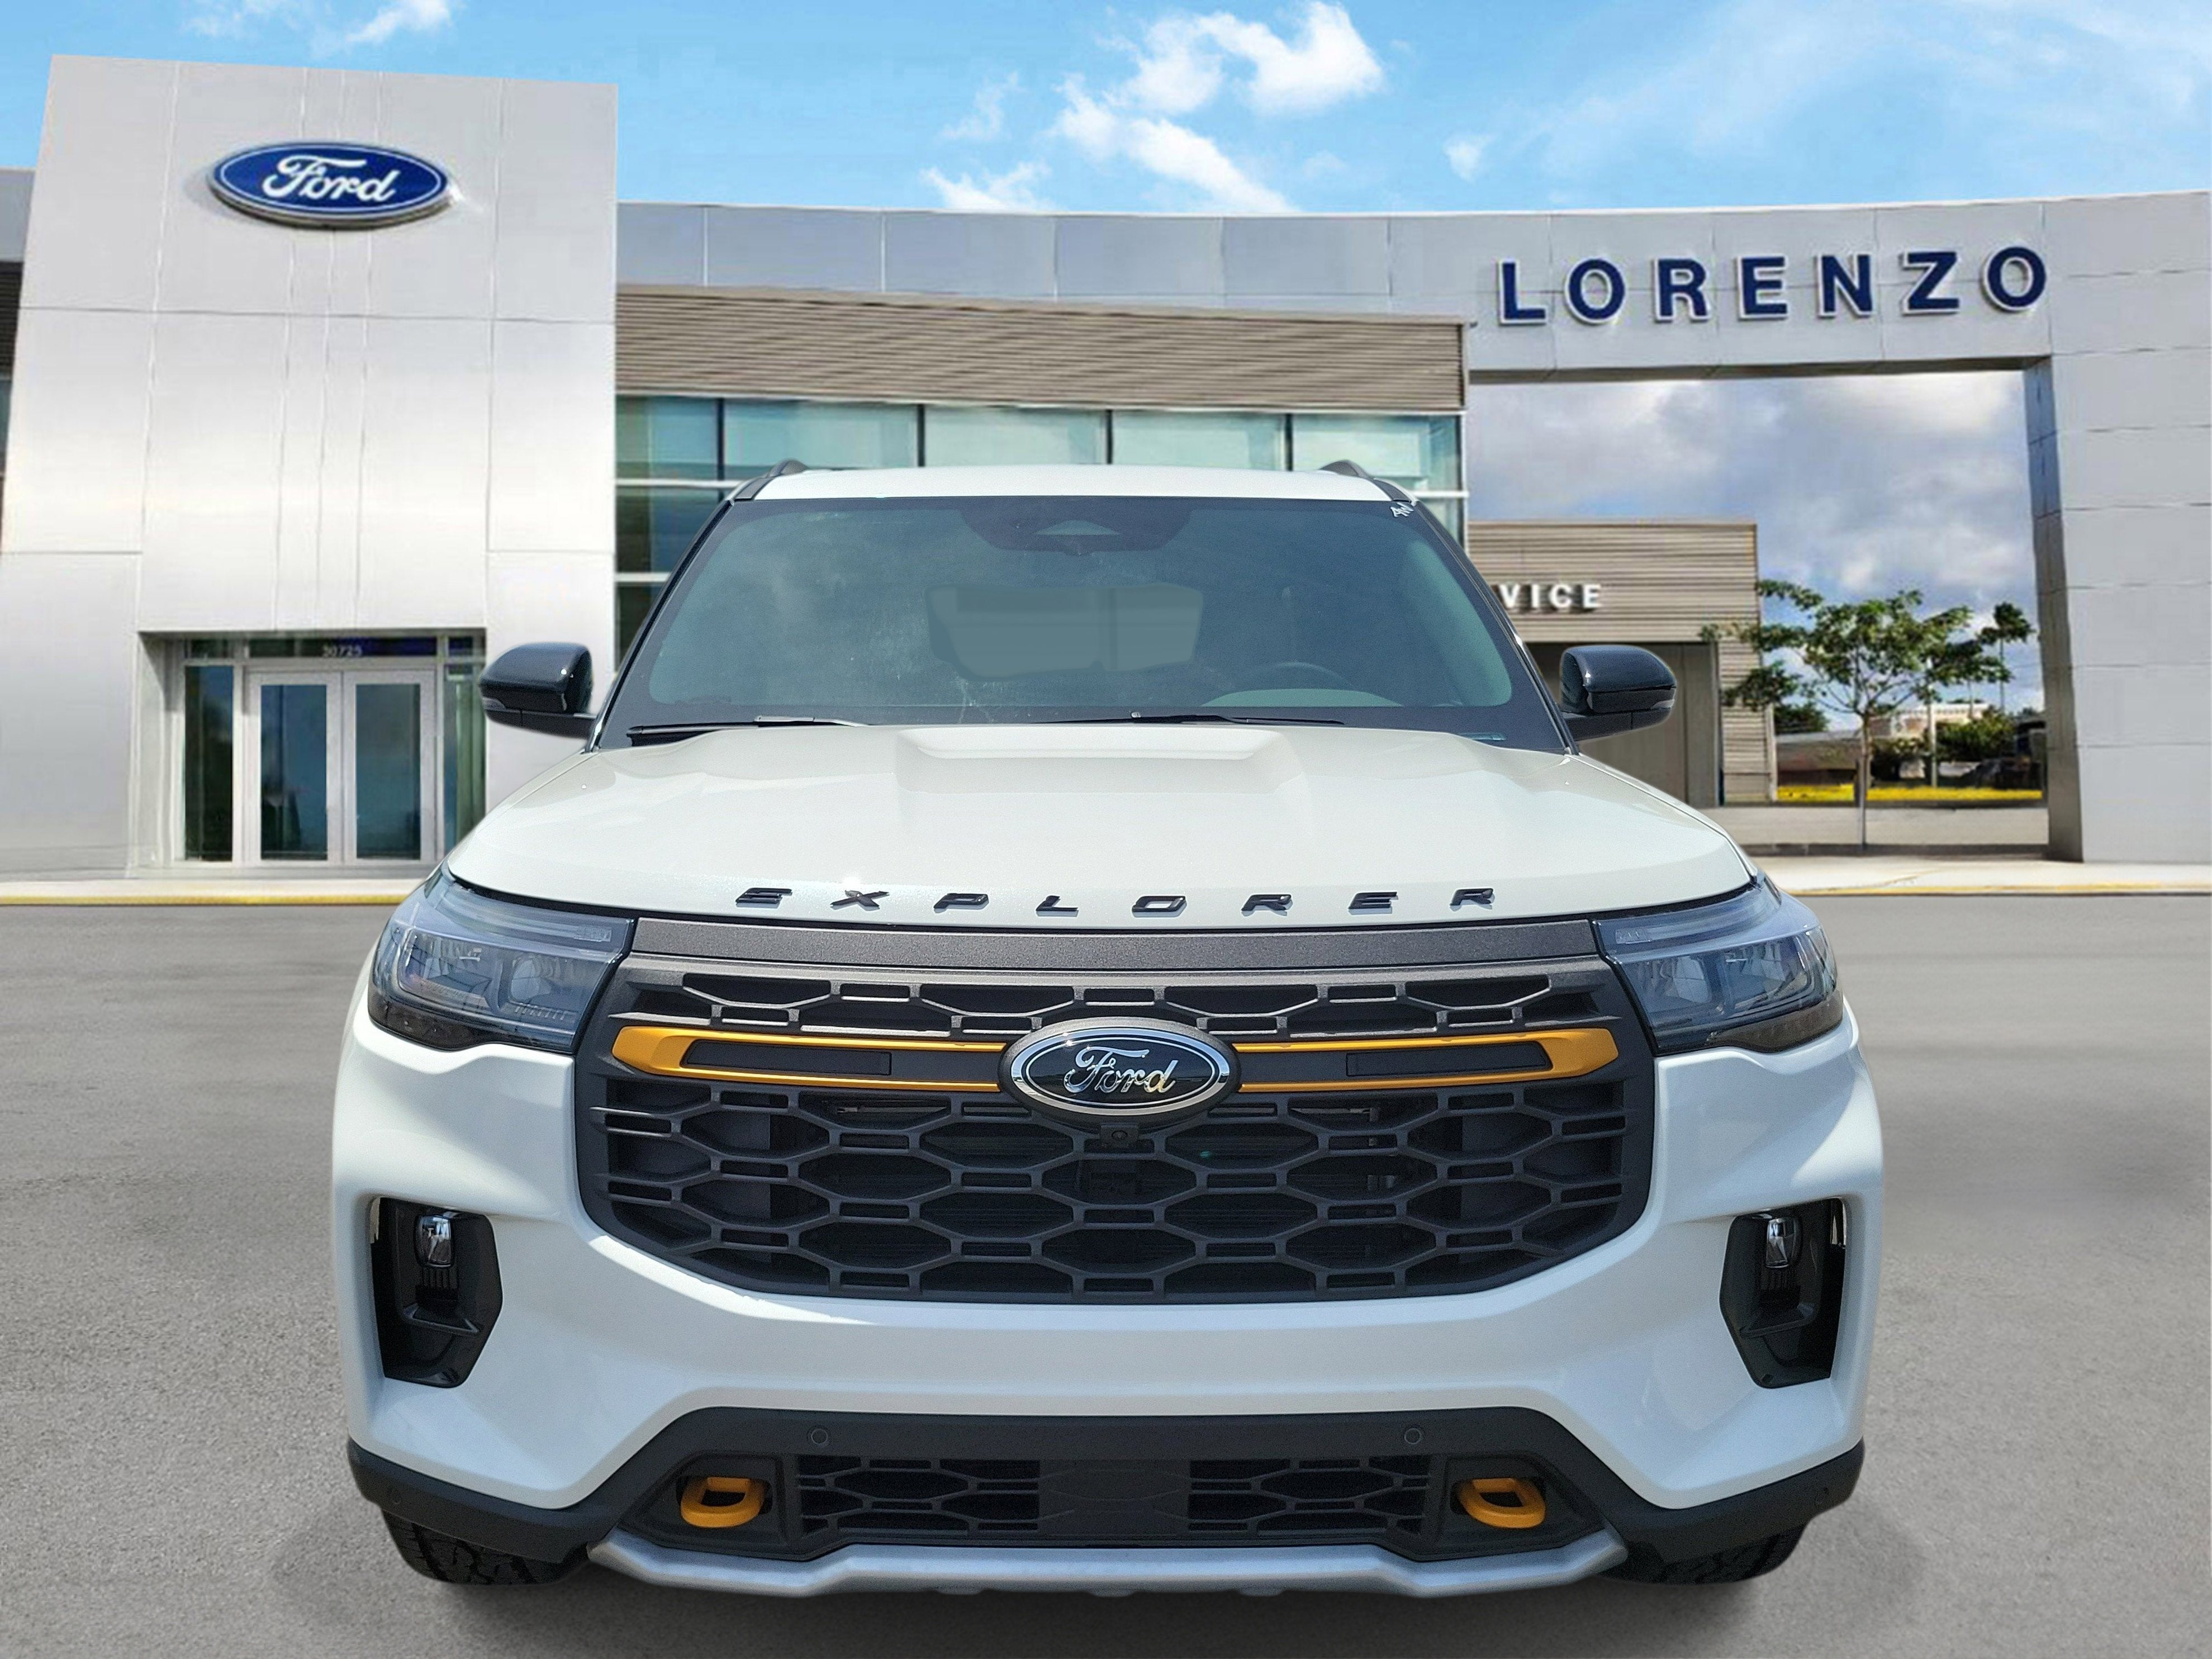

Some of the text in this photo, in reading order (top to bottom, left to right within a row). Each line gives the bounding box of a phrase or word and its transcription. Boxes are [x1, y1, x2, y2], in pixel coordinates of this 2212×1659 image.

[262, 154, 400, 201] Ford
[1499, 246, 2047, 324] LORENZO
[1498, 583, 1602, 609] VICE
[735, 887, 1494, 916] EXPLORER
[1064, 1046, 1178, 1093] Ford
